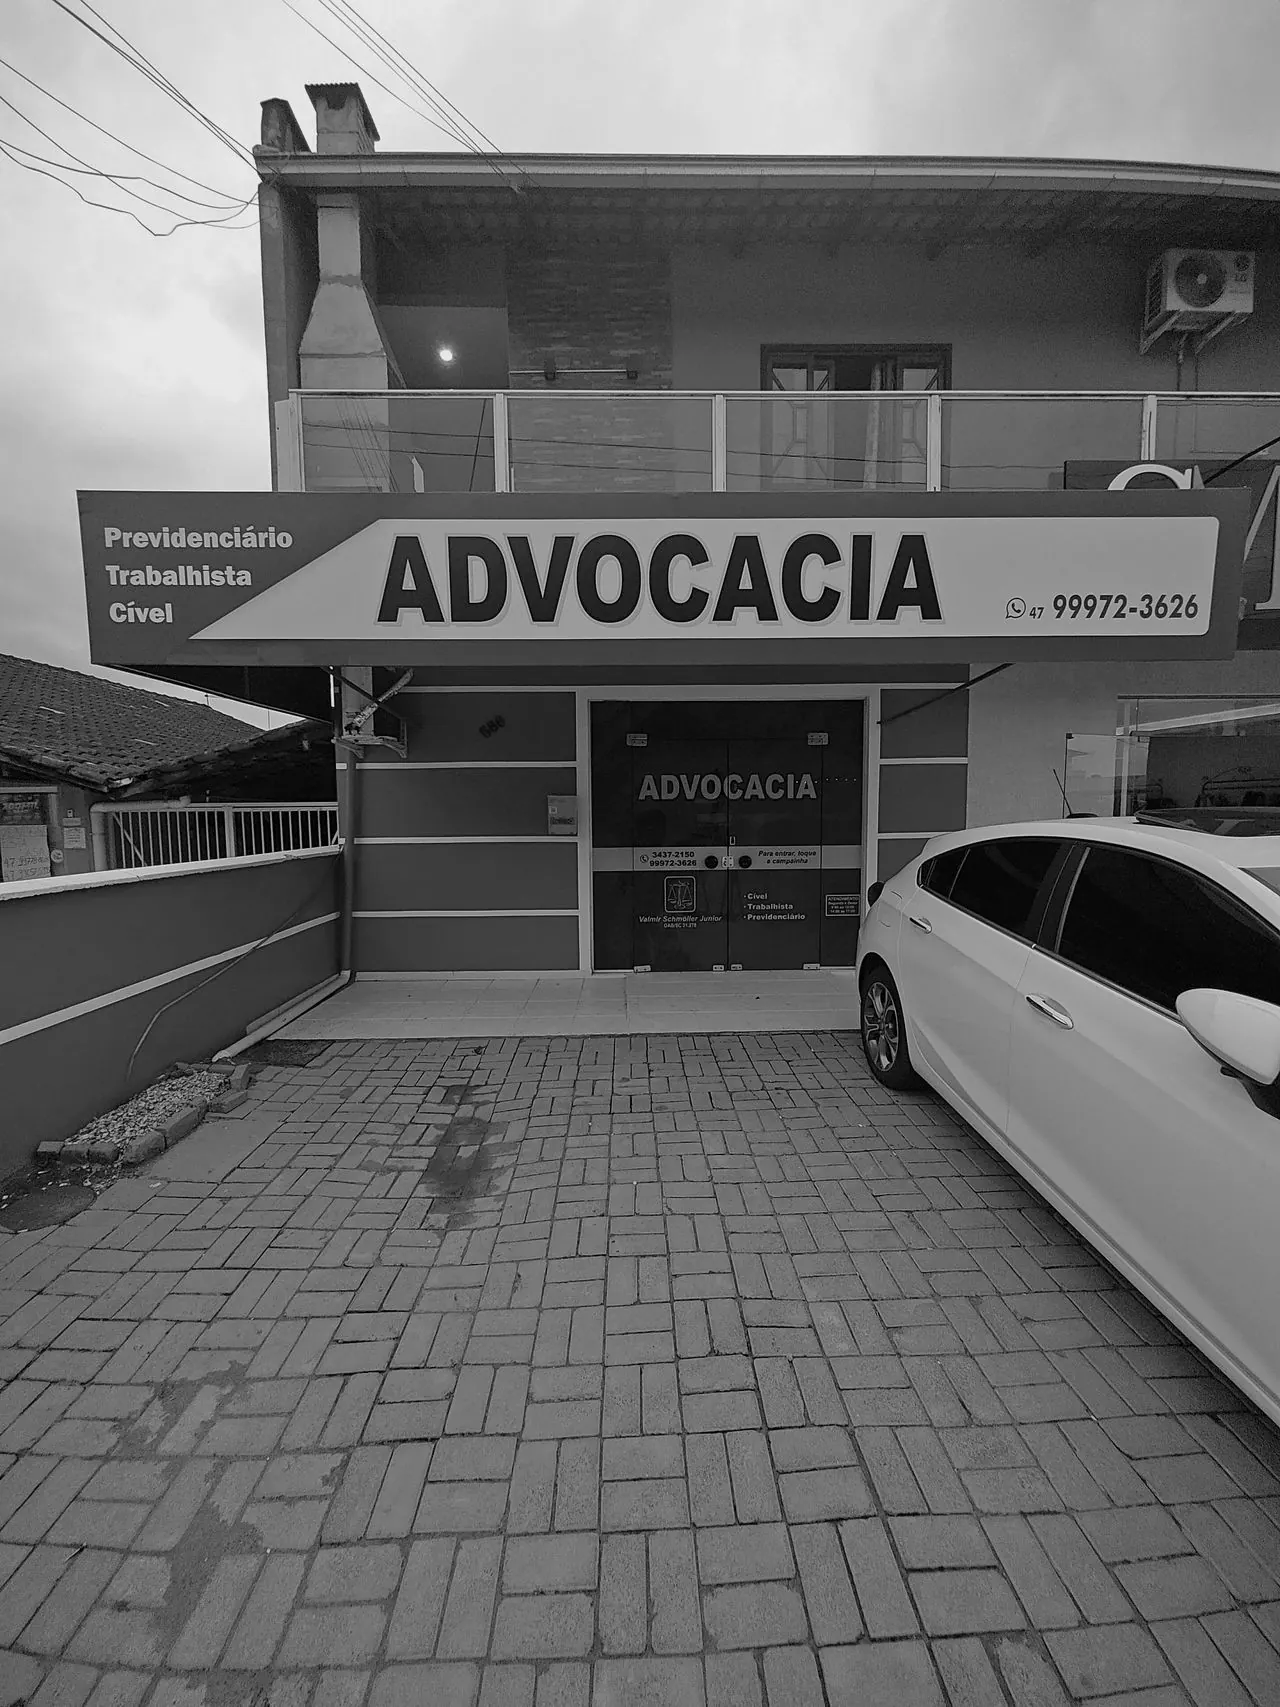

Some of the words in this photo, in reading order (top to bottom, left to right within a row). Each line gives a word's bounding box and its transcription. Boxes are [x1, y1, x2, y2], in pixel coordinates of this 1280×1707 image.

[104, 525, 293, 549] Previdenciário
[105, 564, 252, 586] Trabalhista
[376, 533, 944, 625] ADVOCACIA
[109, 601, 173, 623] Cível
[1028, 606, 1044, 619] 47
[1052, 594, 1198, 619] 99972-3626
[638, 774, 817, 800] ADVOCACIA
[652, 851, 695, 859] 3437-2150
[747, 892, 768, 900] Cível
[747, 913, 806, 921] Previdenciário
